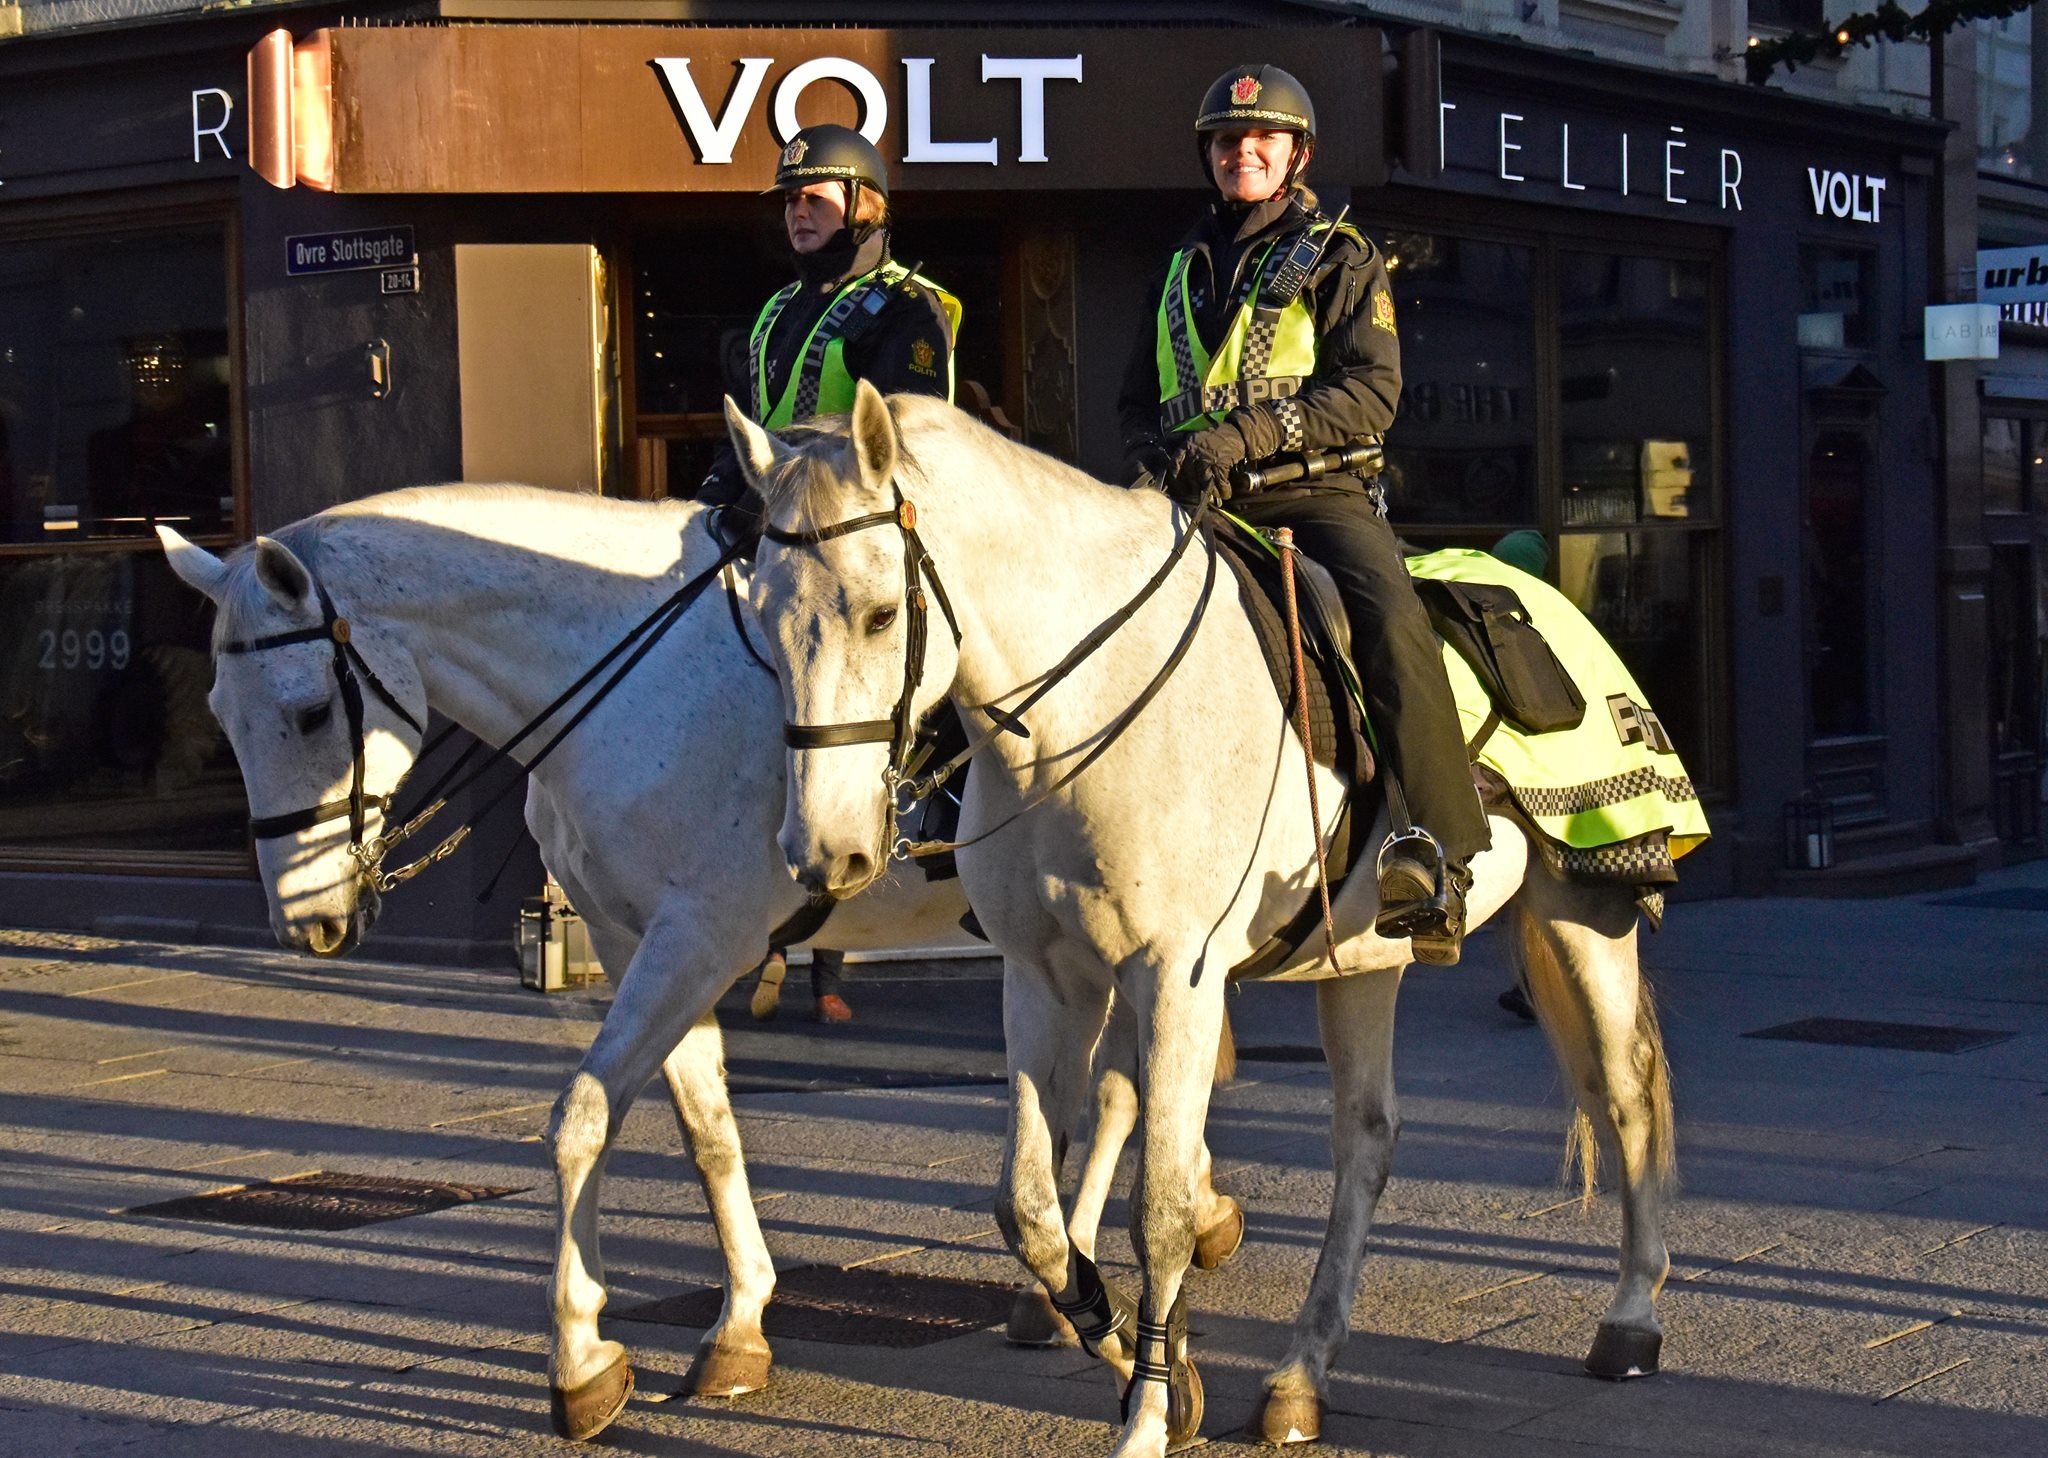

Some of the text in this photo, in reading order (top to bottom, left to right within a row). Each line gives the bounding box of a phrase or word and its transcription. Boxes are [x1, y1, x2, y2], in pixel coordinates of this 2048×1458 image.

[655, 53, 1083, 166] VOLT
[1807, 166, 1887, 223] VOLT
[296, 234, 404, 265] Øvre Slottsgate
[1984, 256, 2048, 290] urb
[1930, 322, 1972, 340] LAB
[907, 363, 937, 379] POLITI
[37, 628, 131, 671] 2999
